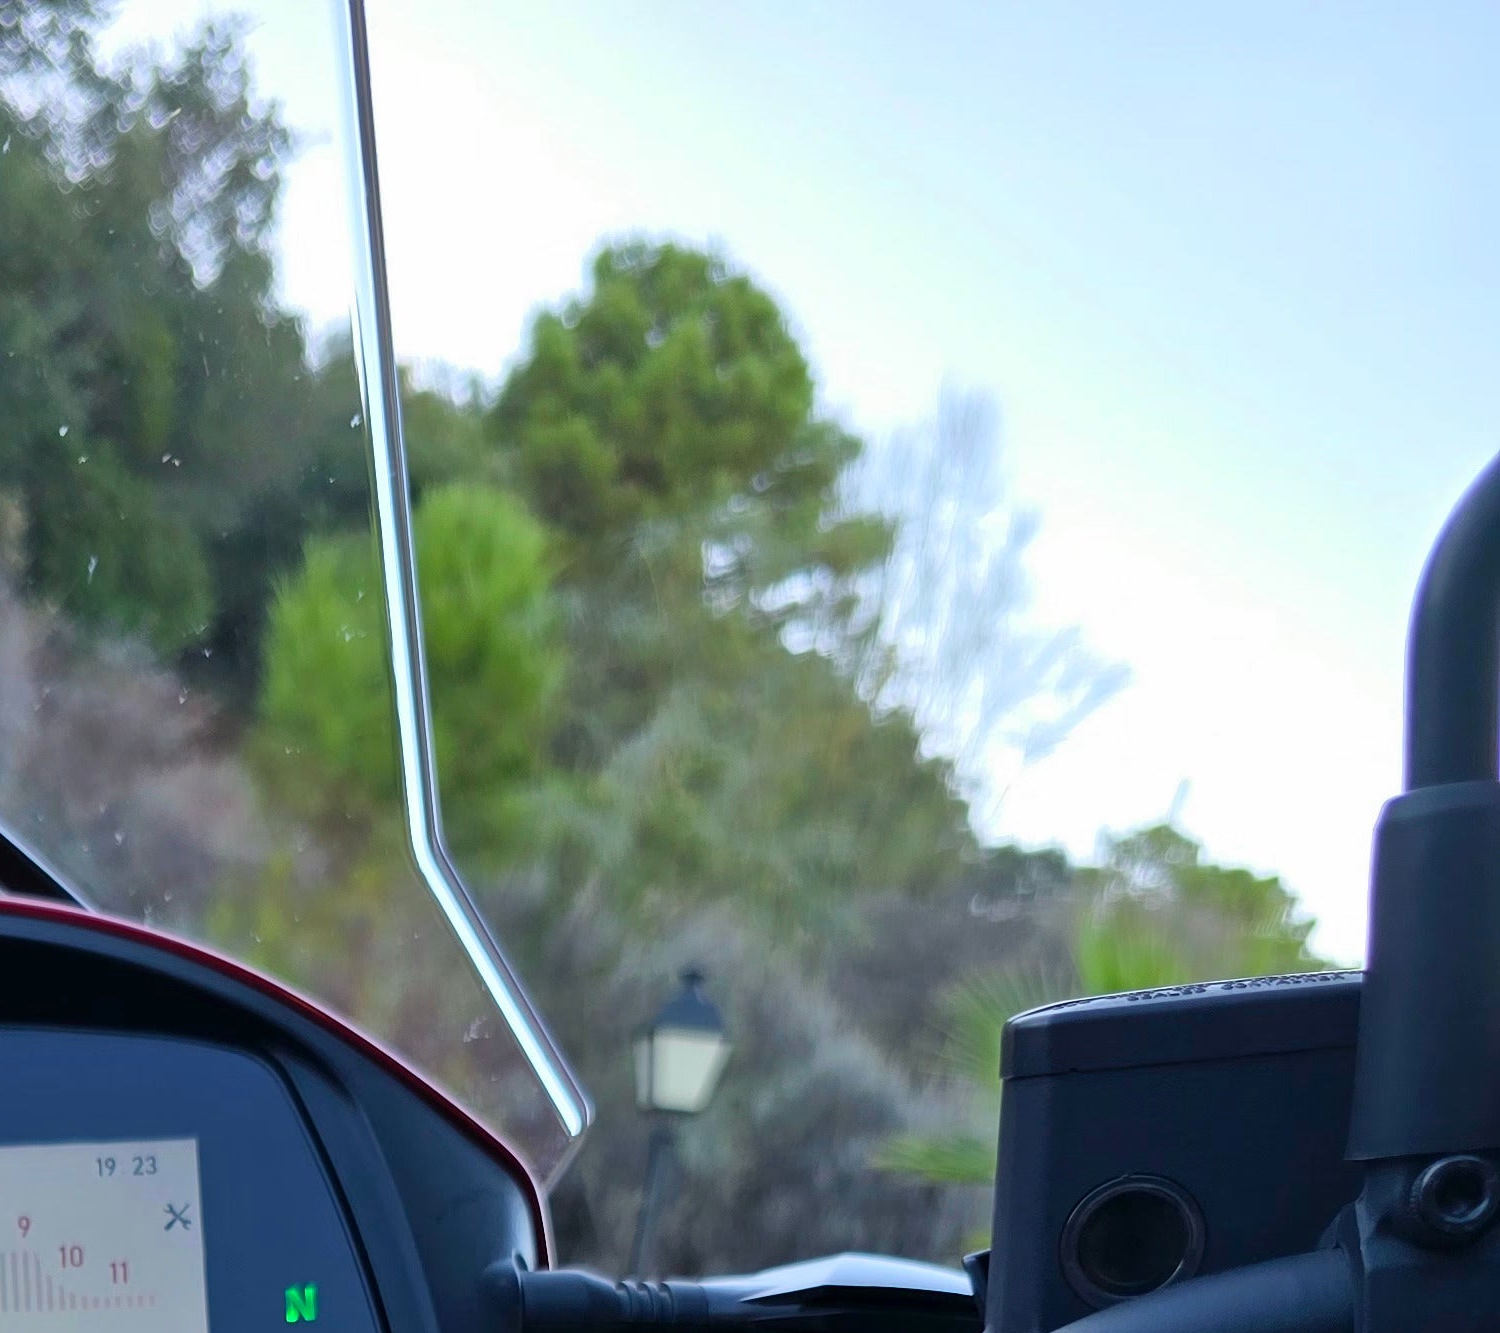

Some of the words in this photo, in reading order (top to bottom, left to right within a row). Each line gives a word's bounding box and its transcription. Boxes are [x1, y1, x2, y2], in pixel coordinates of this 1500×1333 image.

[17, 1216, 31, 1238] 9
[59, 1246, 84, 1269] 10
[109, 1260, 130, 1285] 11
[285, 1284, 317, 1323] N
